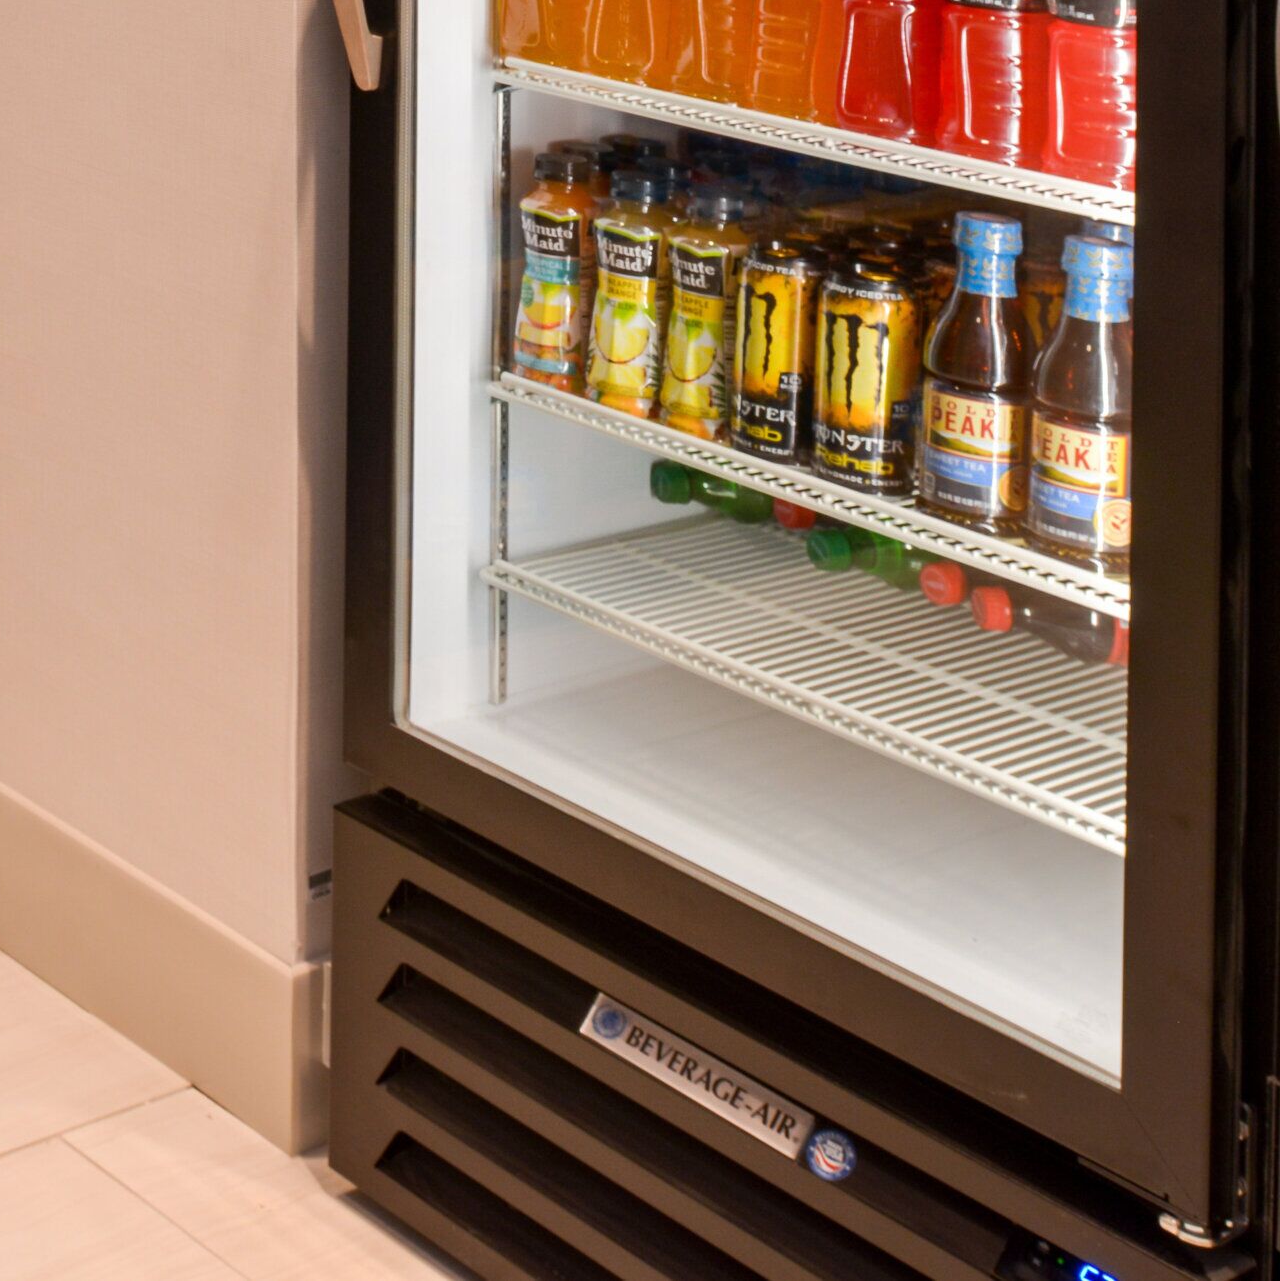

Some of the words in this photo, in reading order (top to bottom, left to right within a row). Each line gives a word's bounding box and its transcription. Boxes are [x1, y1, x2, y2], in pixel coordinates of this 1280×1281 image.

[522, 218, 574, 240] Minute
[526, 233, 566, 253] Maid
[598, 239, 654, 260] Minute
[603, 253, 645, 272] Maid
[931, 405, 996, 440] PEAK
[816, 443, 894, 475] Rehab
[1041, 438, 1091, 471] EAK
[625, 1024, 800, 1144] BEVERAGE-AIR
